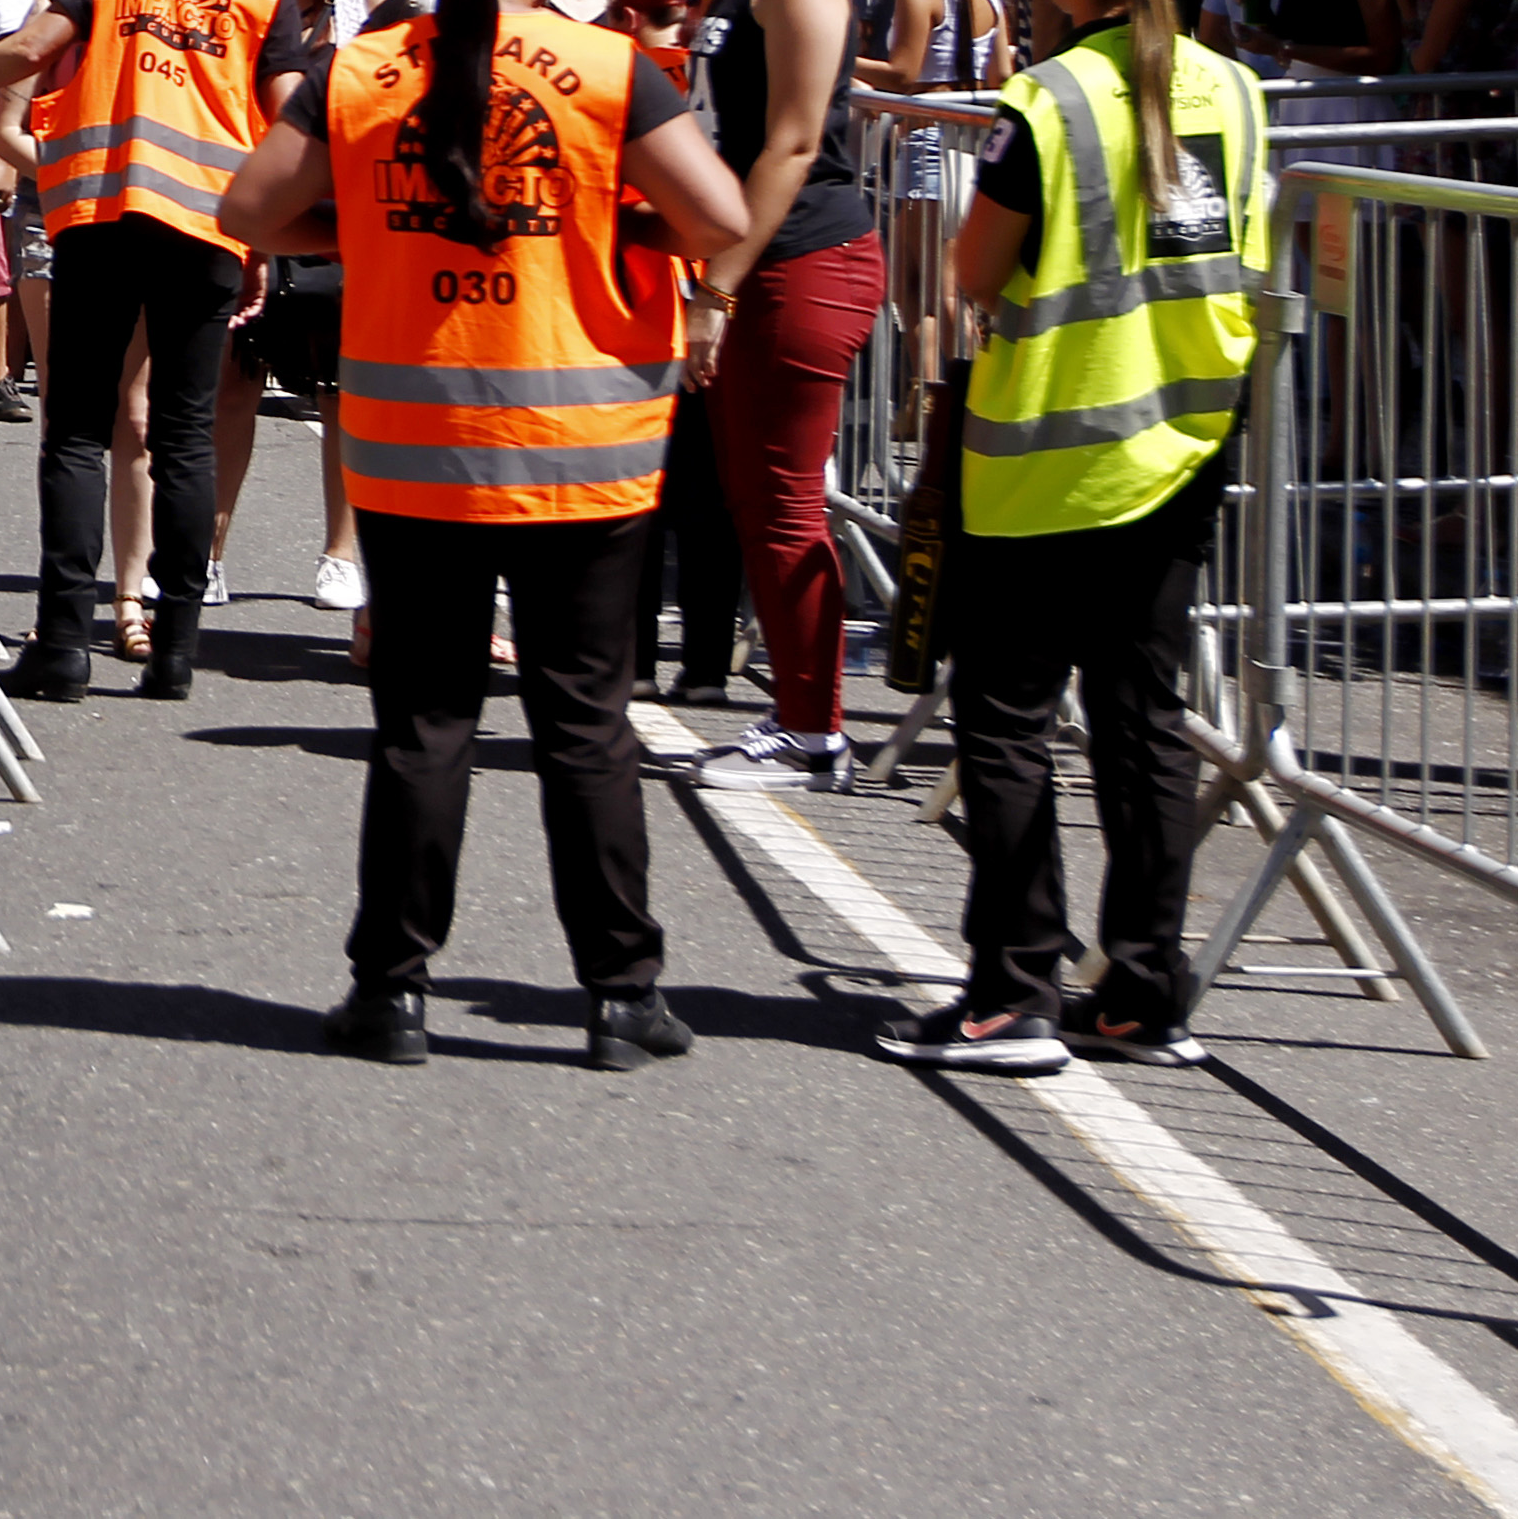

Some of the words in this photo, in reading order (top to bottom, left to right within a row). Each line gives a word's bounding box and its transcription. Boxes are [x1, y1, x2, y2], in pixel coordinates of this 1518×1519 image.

[139, 51, 186, 87] 045
[374, 36, 581, 96] STARD
[374, 159, 576, 209] IMCTO
[390, 214, 556, 232] SECITY
[432, 270, 517, 305] 030
